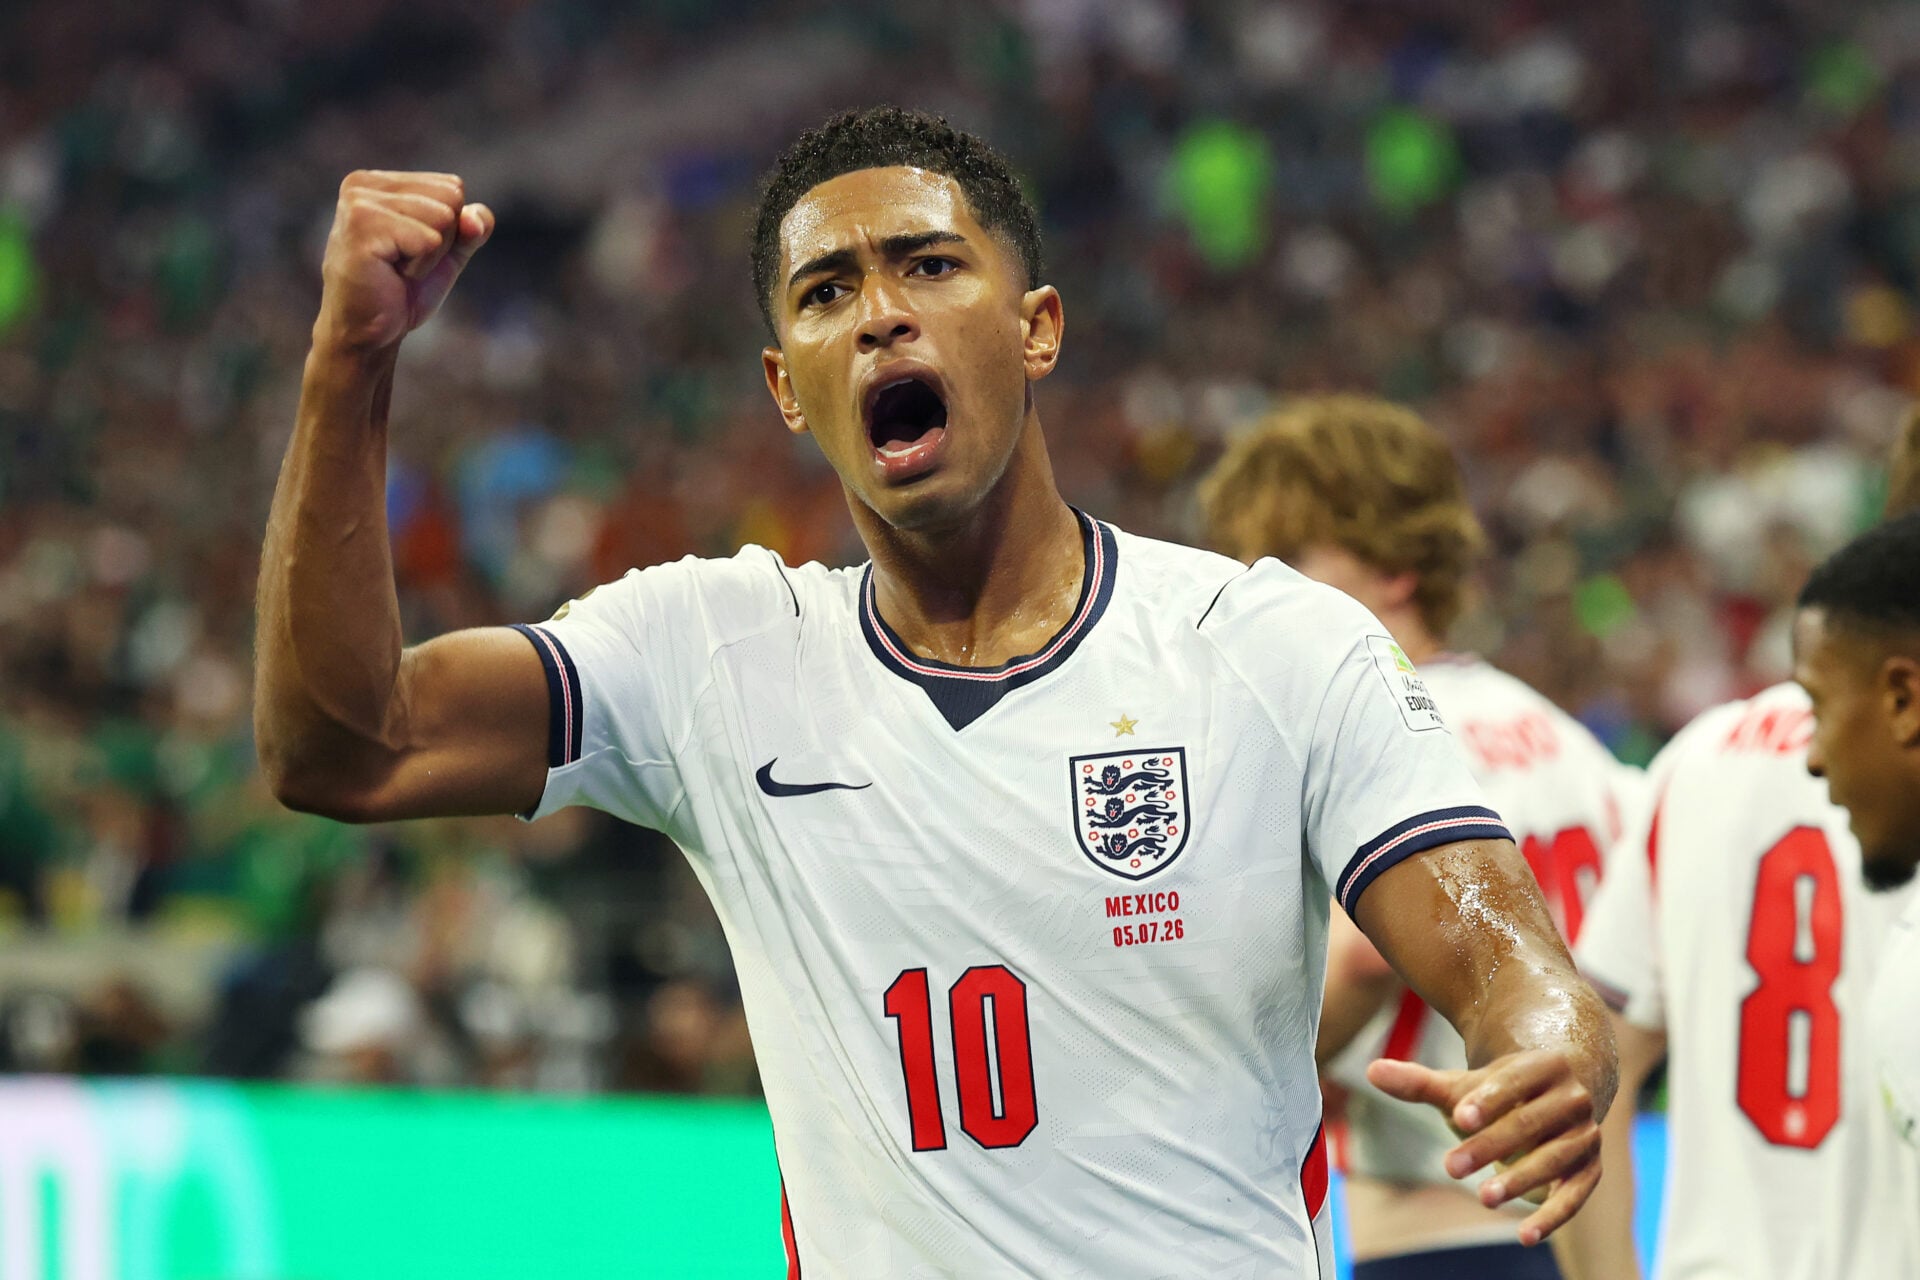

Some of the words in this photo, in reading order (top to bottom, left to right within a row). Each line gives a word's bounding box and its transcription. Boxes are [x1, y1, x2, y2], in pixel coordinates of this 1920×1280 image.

[1104, 890, 1180, 918] MEXICO
[1112, 918, 1185, 948] 05.07.26
[1737, 825, 1843, 1150] 8
[883, 964, 1039, 1153] 10
